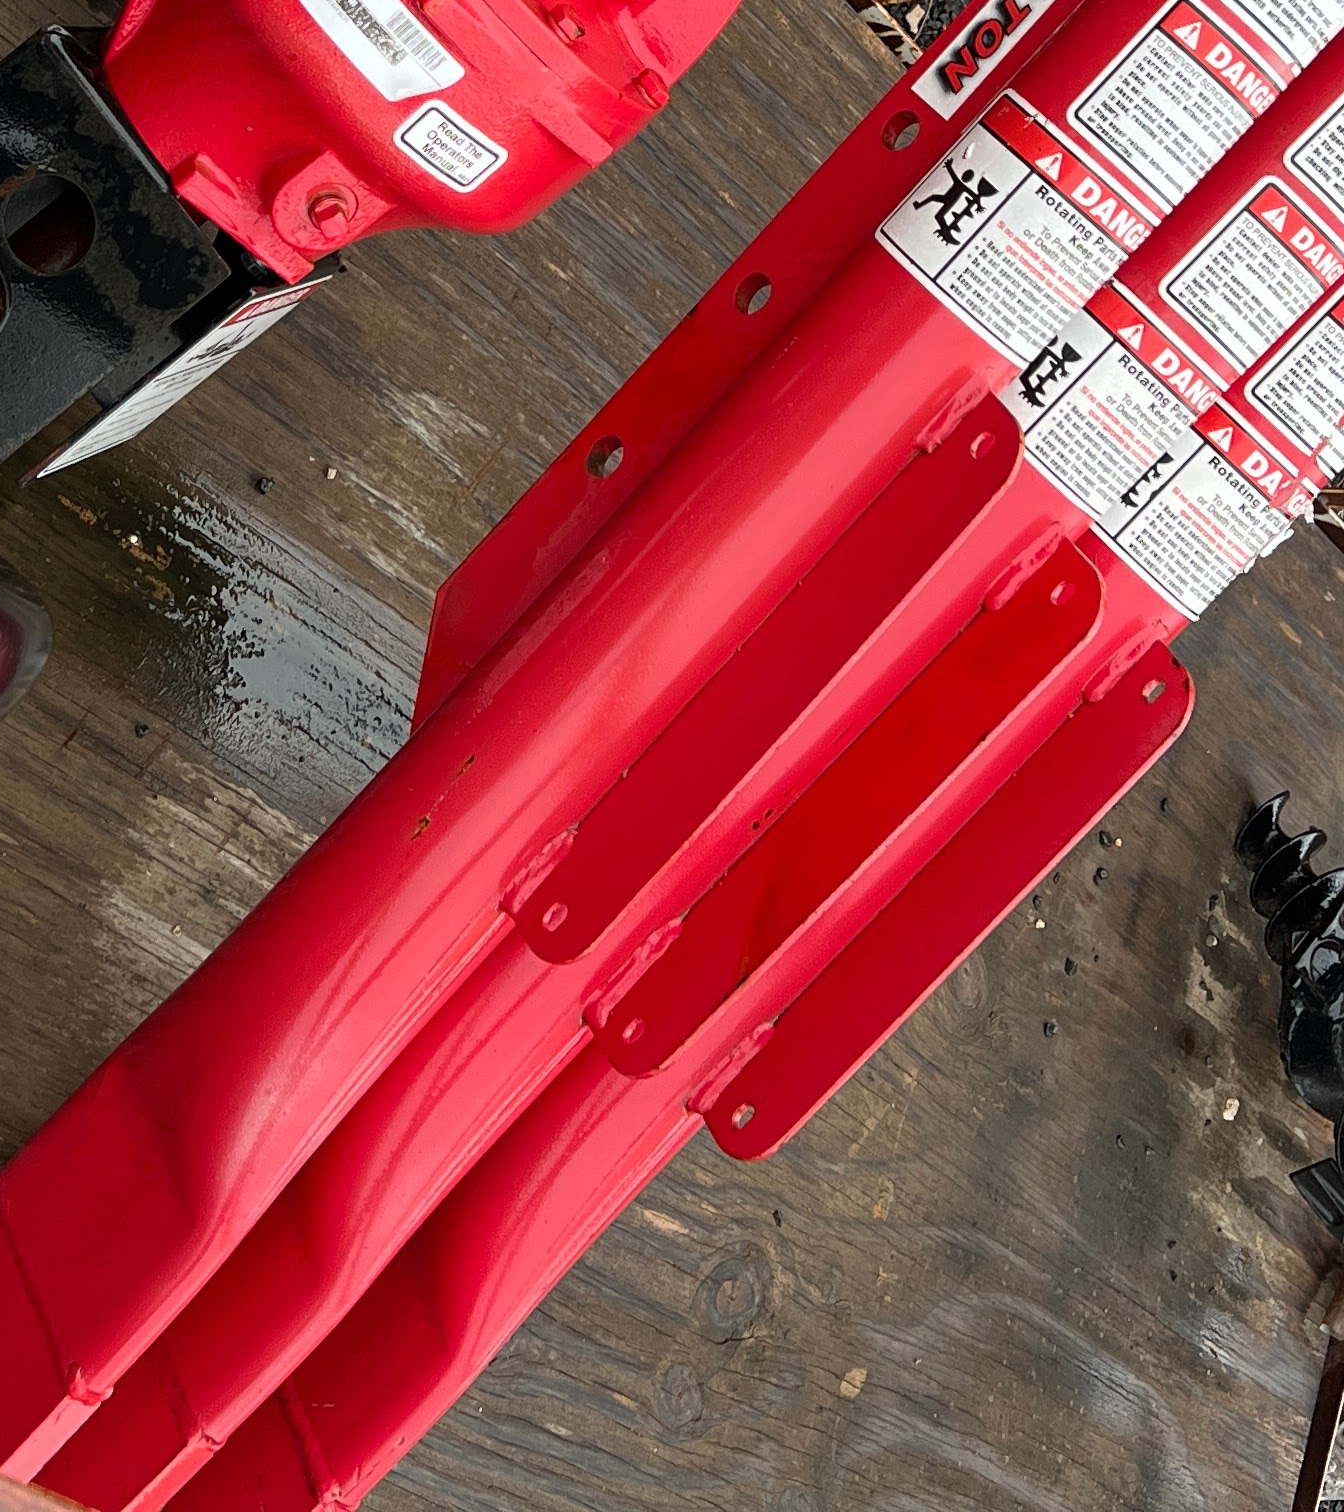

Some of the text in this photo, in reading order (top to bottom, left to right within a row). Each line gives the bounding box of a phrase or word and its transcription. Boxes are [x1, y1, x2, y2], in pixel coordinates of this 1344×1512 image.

[1162, 45, 1203, 81] PREVENT
[423, 128, 475, 171] Operators
[436, 120, 485, 160] Read The
[1034, 184, 1119, 262] Rotating Parts
[1021, 228, 1079, 277] or Death from
[1038, 225, 1084, 266] To Prevent
[1067, 234, 1095, 262] Keep
[1117, 353, 1171, 409] Rotating
[1147, 402, 1171, 425] Keep
[1207, 455, 1262, 510] Rotating
[1237, 502, 1261, 527] Keep
